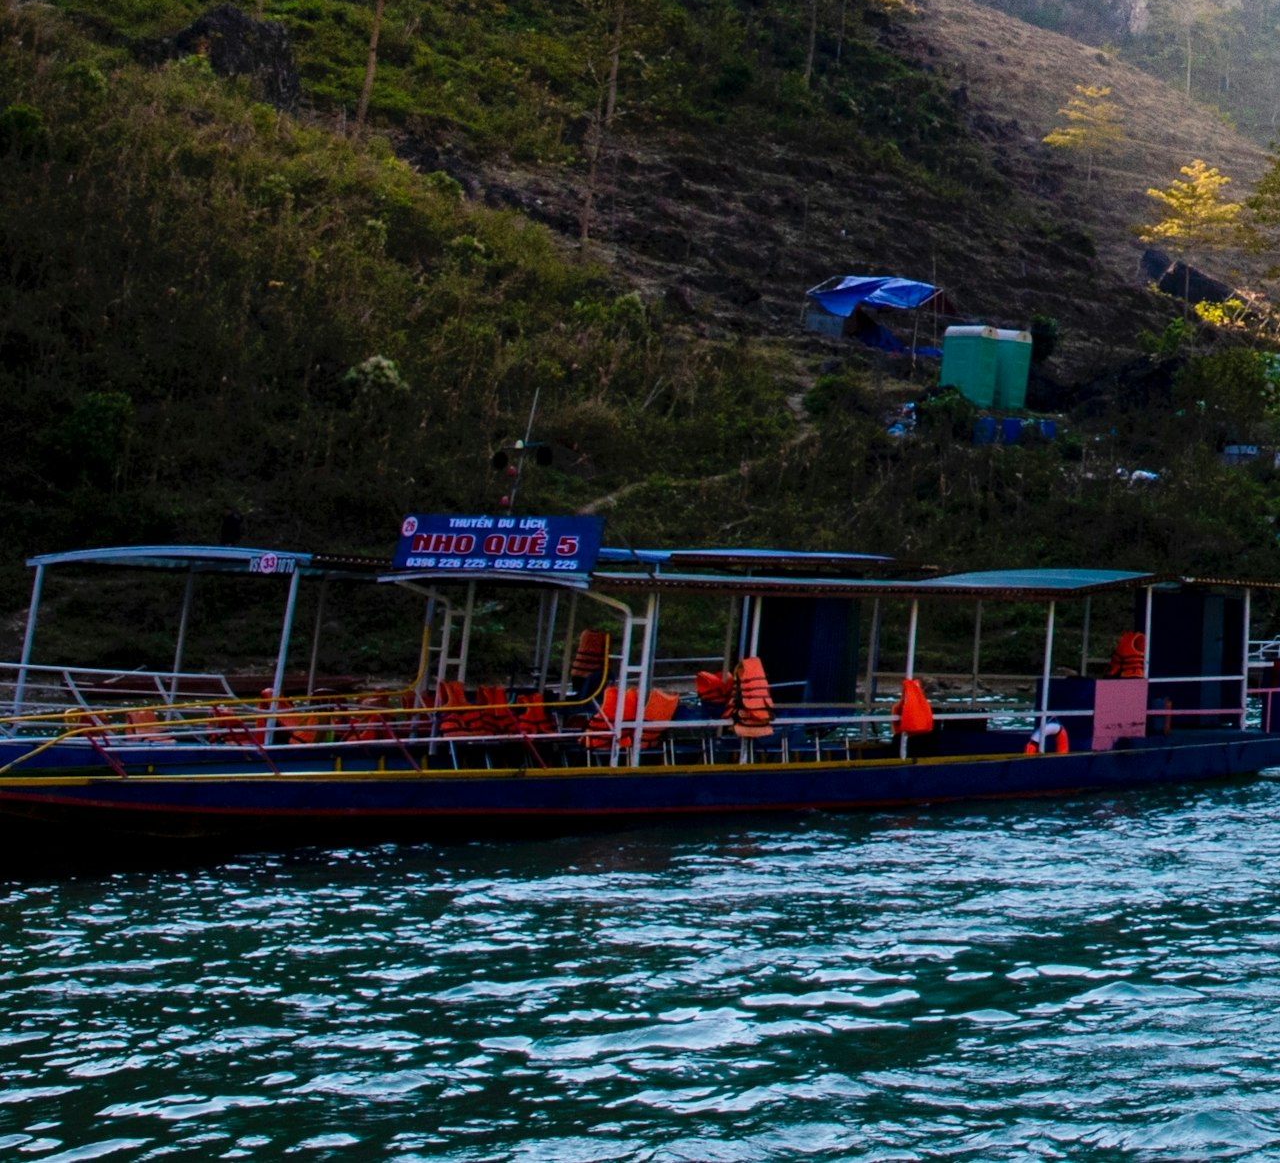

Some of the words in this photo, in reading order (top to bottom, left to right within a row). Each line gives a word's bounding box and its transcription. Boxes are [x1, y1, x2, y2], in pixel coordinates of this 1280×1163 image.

[497, 518, 515, 528] DU
[411, 533, 476, 554] NHO
[483, 528, 549, 556] QUẾ
[555, 535, 579, 556] 5
[438, 557, 461, 568] 226
[463, 558, 487, 568] 225
[526, 559, 551, 569] 226
[553, 560, 578, 570] 225
